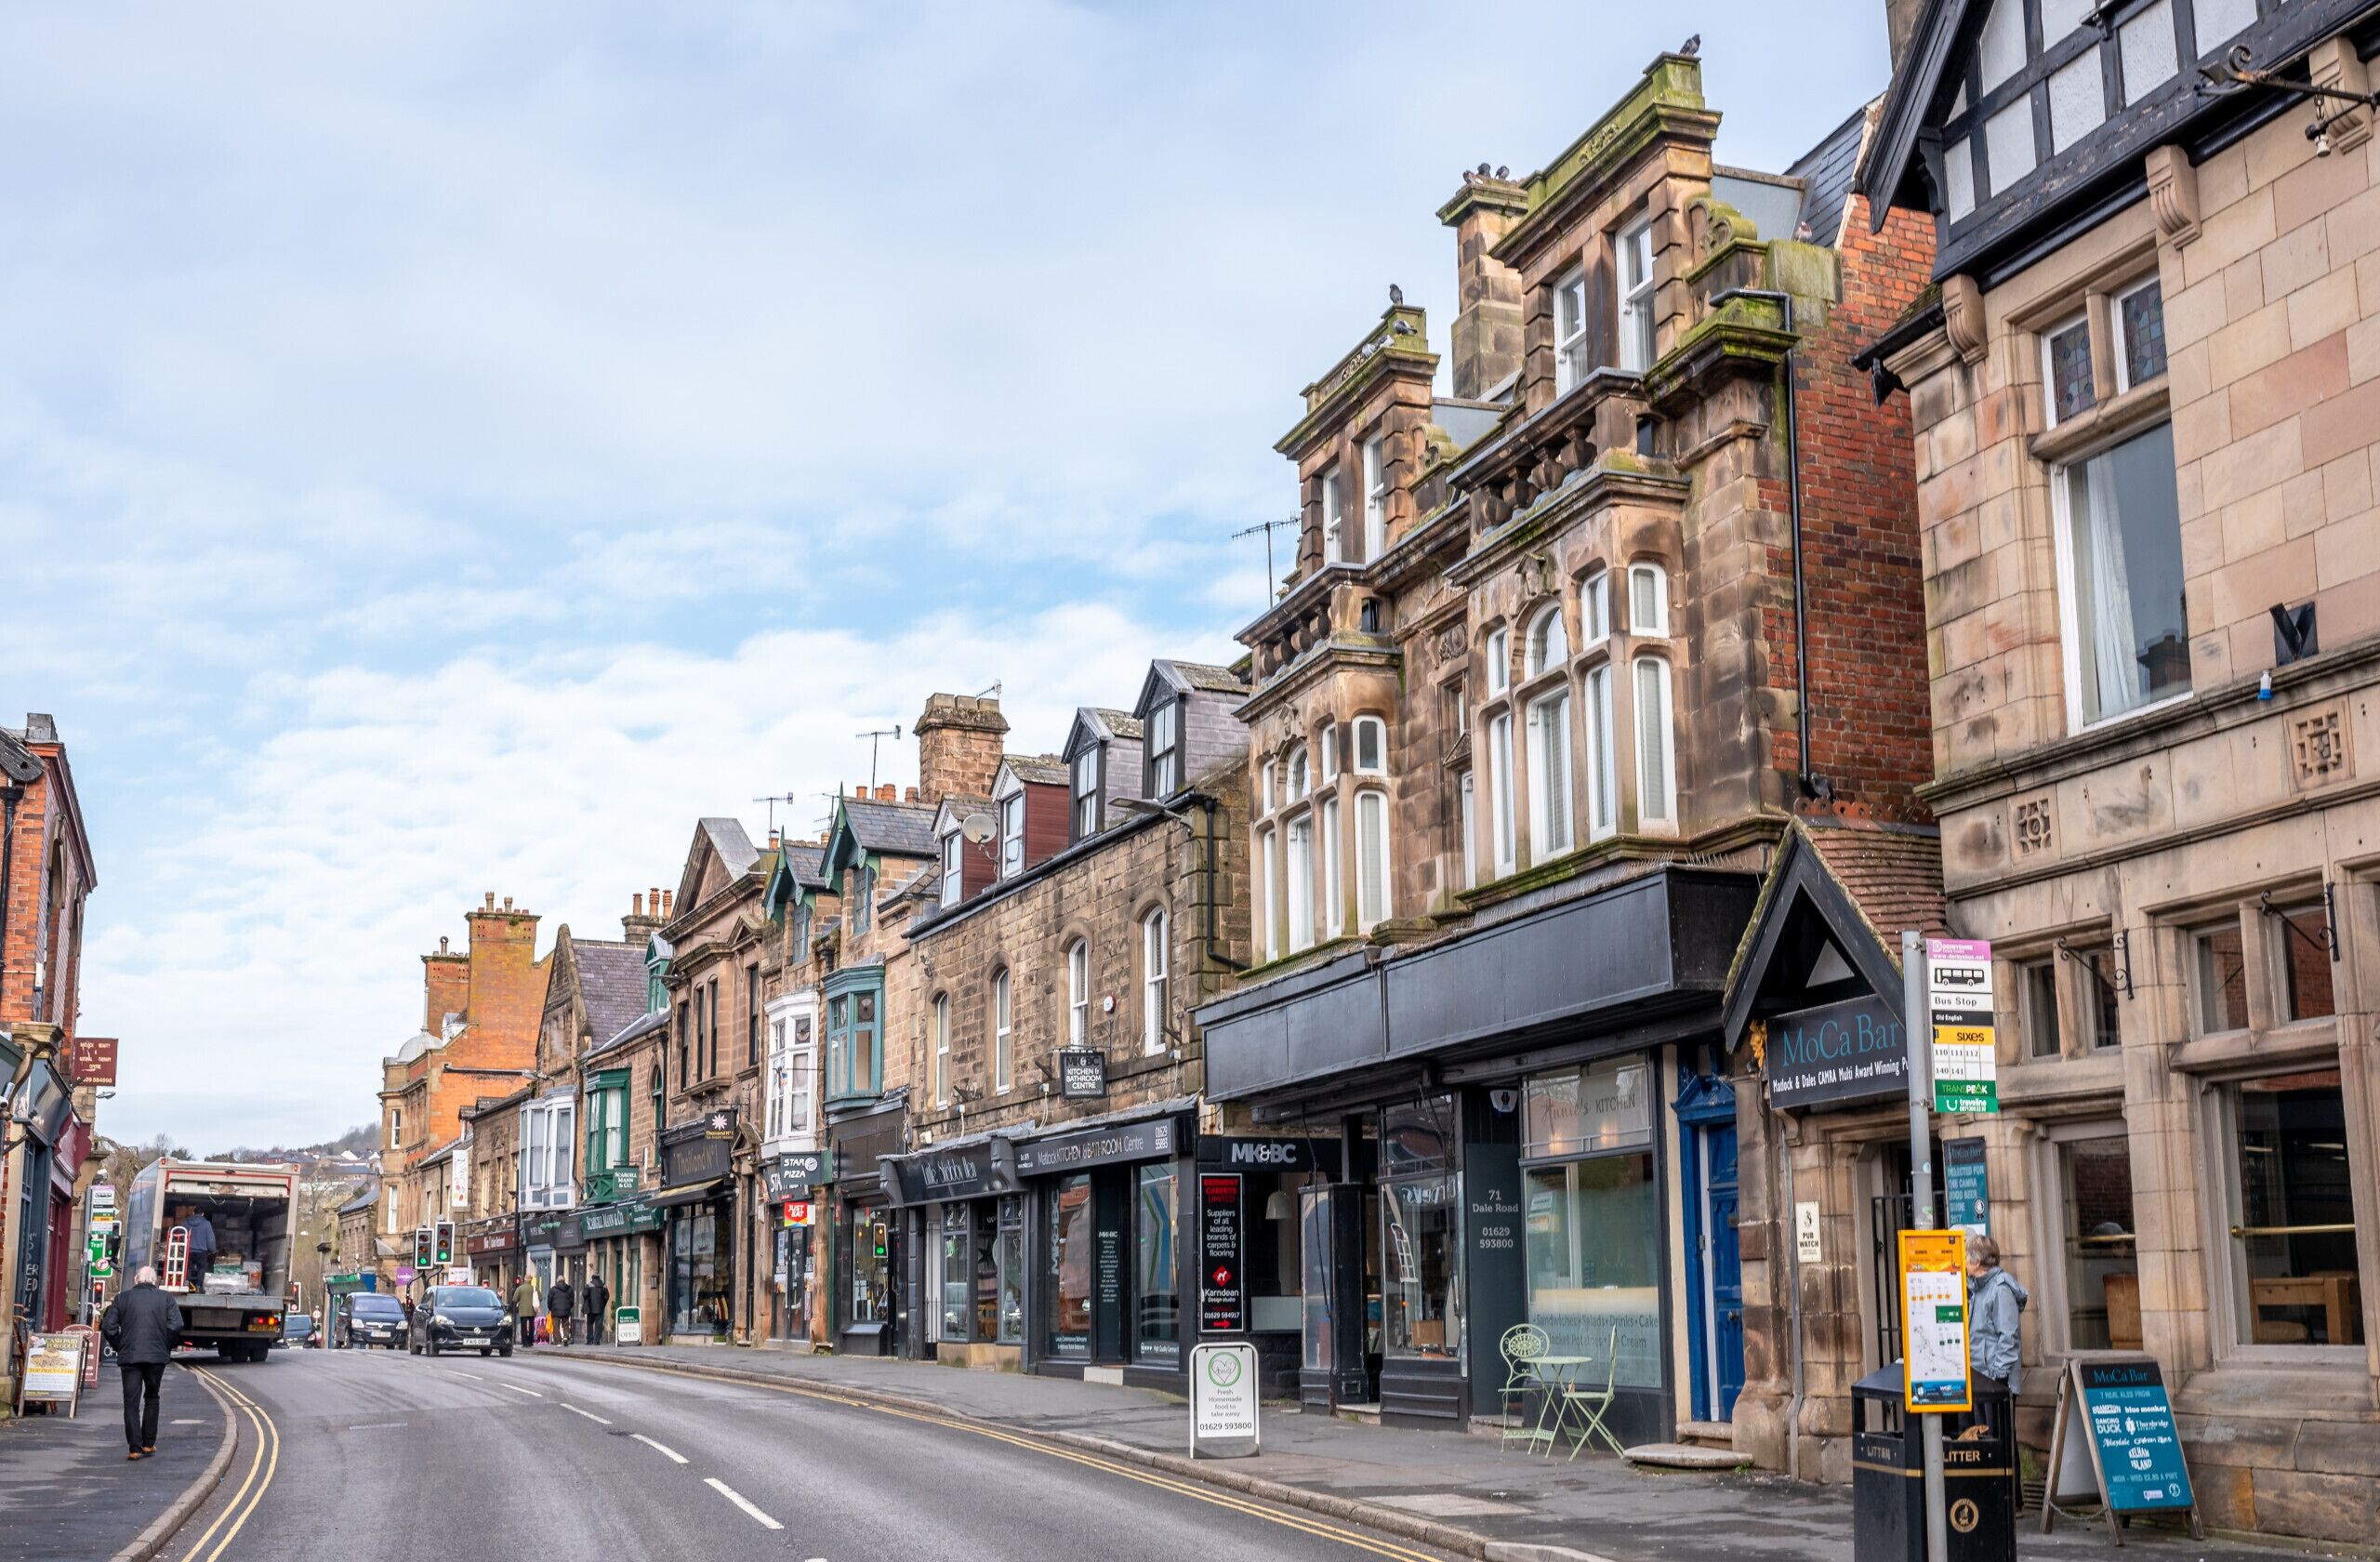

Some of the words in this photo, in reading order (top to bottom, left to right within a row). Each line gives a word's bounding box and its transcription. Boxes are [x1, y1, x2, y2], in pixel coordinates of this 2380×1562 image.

[1935, 997, 1951, 1005] Bus
[1955, 997, 1977, 1006] Stop
[1783, 1020, 1852, 1067] MoCa
[1856, 1013, 1898, 1052] Bar
[1066, 1056, 1100, 1066] MK&BC
[1773, 1076, 1792, 1092] Matlock
[1795, 1075, 1800, 1088] &
[1802, 1072, 1816, 1088] Dales
[1818, 1068, 1836, 1085] CAMRA
[1839, 1066, 1853, 1081] Multi
[1855, 1062, 1873, 1079] Award
[1873, 1058, 1900, 1077] Winning
[1072, 1081, 1096, 1090] CENTRE
[1942, 1083, 1988, 1095] TRANSPEAK
[1595, 1093, 1635, 1113] KITCHEN
[1155, 1126, 1168, 1138] 01629
[1038, 1151, 1057, 1166] Matlock
[1056, 1145, 1081, 1163] KITCHEN
[1087, 1138, 1123, 1158] BATHROOM
[1123, 1135, 1144, 1152] Centre
[1232, 1143, 1297, 1163] MK&BC
[784, 1158, 805, 1167] STAR
[1973, 1165, 1985, 1175] FOR
[1959, 1177, 1977, 1188] CAMRA
[1488, 1189, 1502, 1201] 71
[1964, 1189, 1977, 1199] BEER
[1472, 1203, 1493, 1213] Dale
[1495, 1203, 1519, 1213] Road
[1207, 1209, 1236, 1219] Suppliers
[1051, 1189, 1060, 1276] MK&BC
[1210, 1225, 1234, 1234] leading
[1482, 1226, 1511, 1237] 01629
[1229, 1233, 1237, 1241] of
[1207, 1241, 1230, 1250] carpets
[1479, 1238, 1514, 1249] 593800
[1210, 1250, 1235, 1258] flooring
[1205, 1289, 1239, 1297] Karndean
[1536, 1314, 1577, 1327] Sandwiches
[1581, 1315, 1606, 1328] Salads
[1609, 1315, 1635, 1328] Drinks
[1620, 1334, 1647, 1348] Cream
[2094, 1369, 2128, 1383] MoCa
[2129, 1369, 2149, 1383] Bar
[2135, 1390, 2150, 1398] FROM
[2124, 1406, 2140, 1414] blue
[2141, 1405, 2167, 1413] monkey
[1199, 1423, 1223, 1432] 01629
[1224, 1421, 1252, 1431] 593800
[2096, 1424, 2122, 1435] DUCK
[1867, 1446, 1891, 1461] LITTER
[1942, 1450, 1981, 1463] LITTER
[2129, 1447, 2150, 1459] KELHAM
[2131, 1459, 2152, 1471] ISLAND
